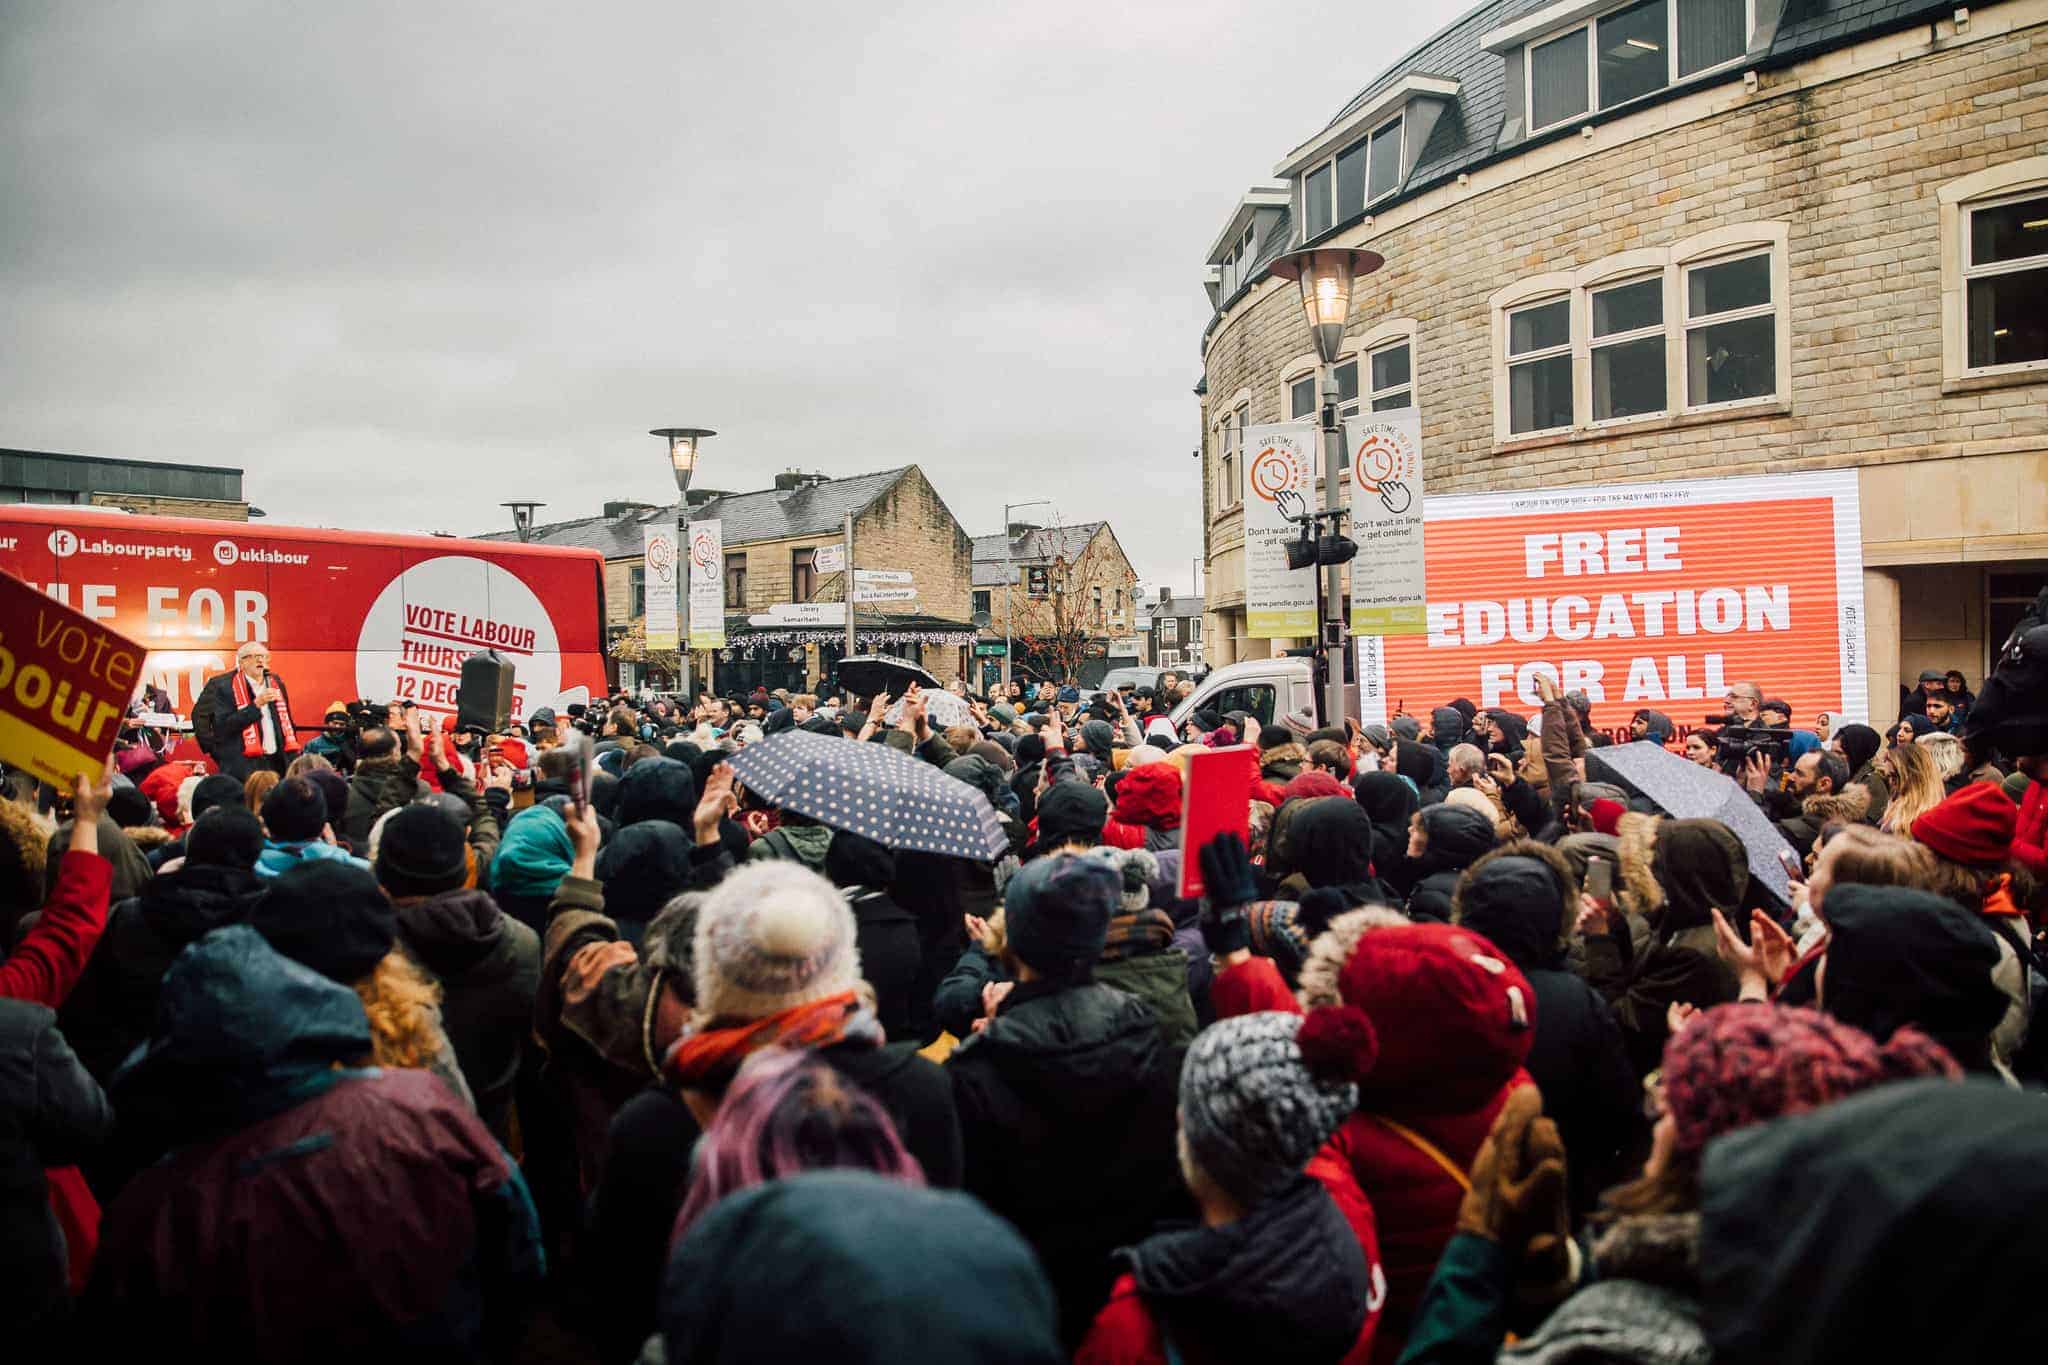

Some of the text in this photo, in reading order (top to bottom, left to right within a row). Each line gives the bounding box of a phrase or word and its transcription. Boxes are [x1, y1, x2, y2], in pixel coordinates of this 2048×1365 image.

[1248, 527, 1270, 536] Don't
[1271, 527, 1288, 535] wait
[1353, 516, 1421, 530] Don't wait in line
[1264, 536, 1277, 547] get
[1367, 530, 1381, 541] get
[79, 538, 193, 562] Labourparty
[240, 549, 310, 565] uklabour
[1524, 526, 1683, 578] FREE
[800, 606, 819, 614] Library
[1355, 594, 1422, 605] www.pendle.gov.uk
[147, 585, 269, 642] FOR
[1426, 584, 1791, 648] EDUCATION
[406, 604, 536, 650] VOTE LABOUR
[37, 609, 136, 691] vote
[395, 675, 416, 699] 12
[1480, 653, 1737, 709] FOR ALL
